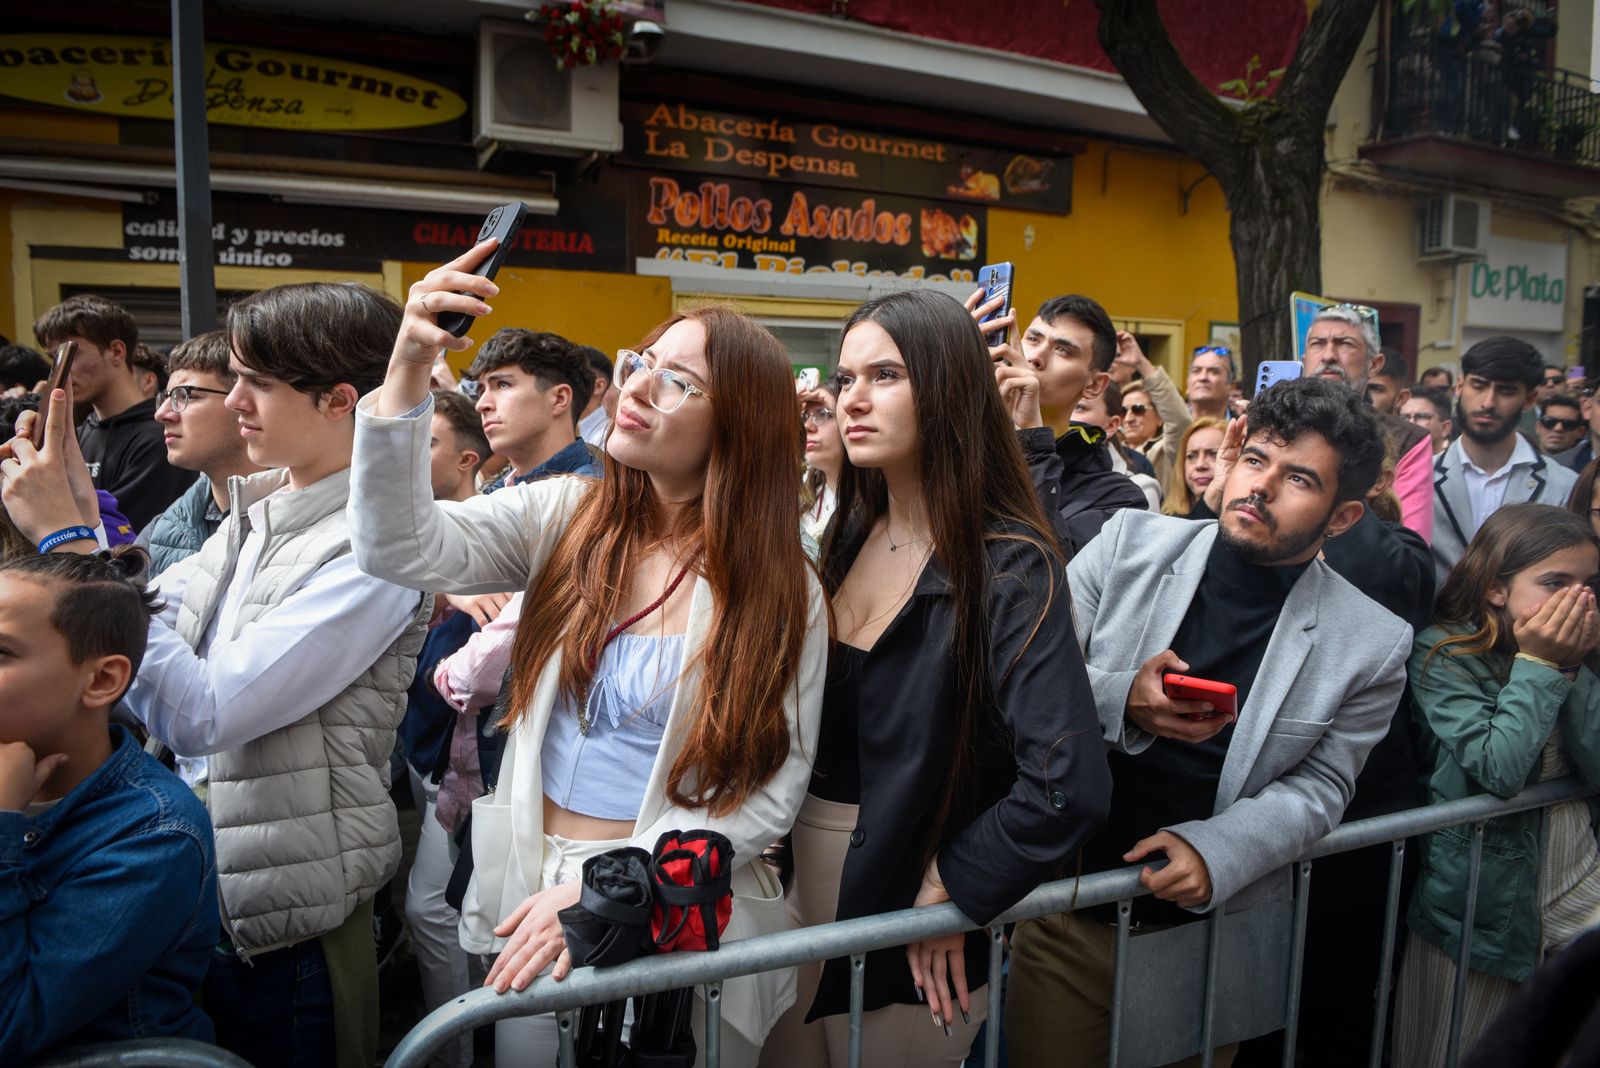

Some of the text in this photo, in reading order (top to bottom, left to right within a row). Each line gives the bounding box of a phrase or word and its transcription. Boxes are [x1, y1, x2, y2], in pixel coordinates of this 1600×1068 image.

[123, 77, 305, 115] Dpensa
[205, 67, 246, 94] La
[215, 48, 442, 109] Gourmet
[645, 103, 946, 162] Abacería Gourmet
[645, 130, 858, 177] La Despensa
[647, 176, 912, 245] Pollos Asados
[125, 218, 345, 248] calid y precios
[412, 222, 595, 254] CHATERIA
[657, 228, 796, 253] Receta Original
[1471, 261, 1565, 304] De Plata
